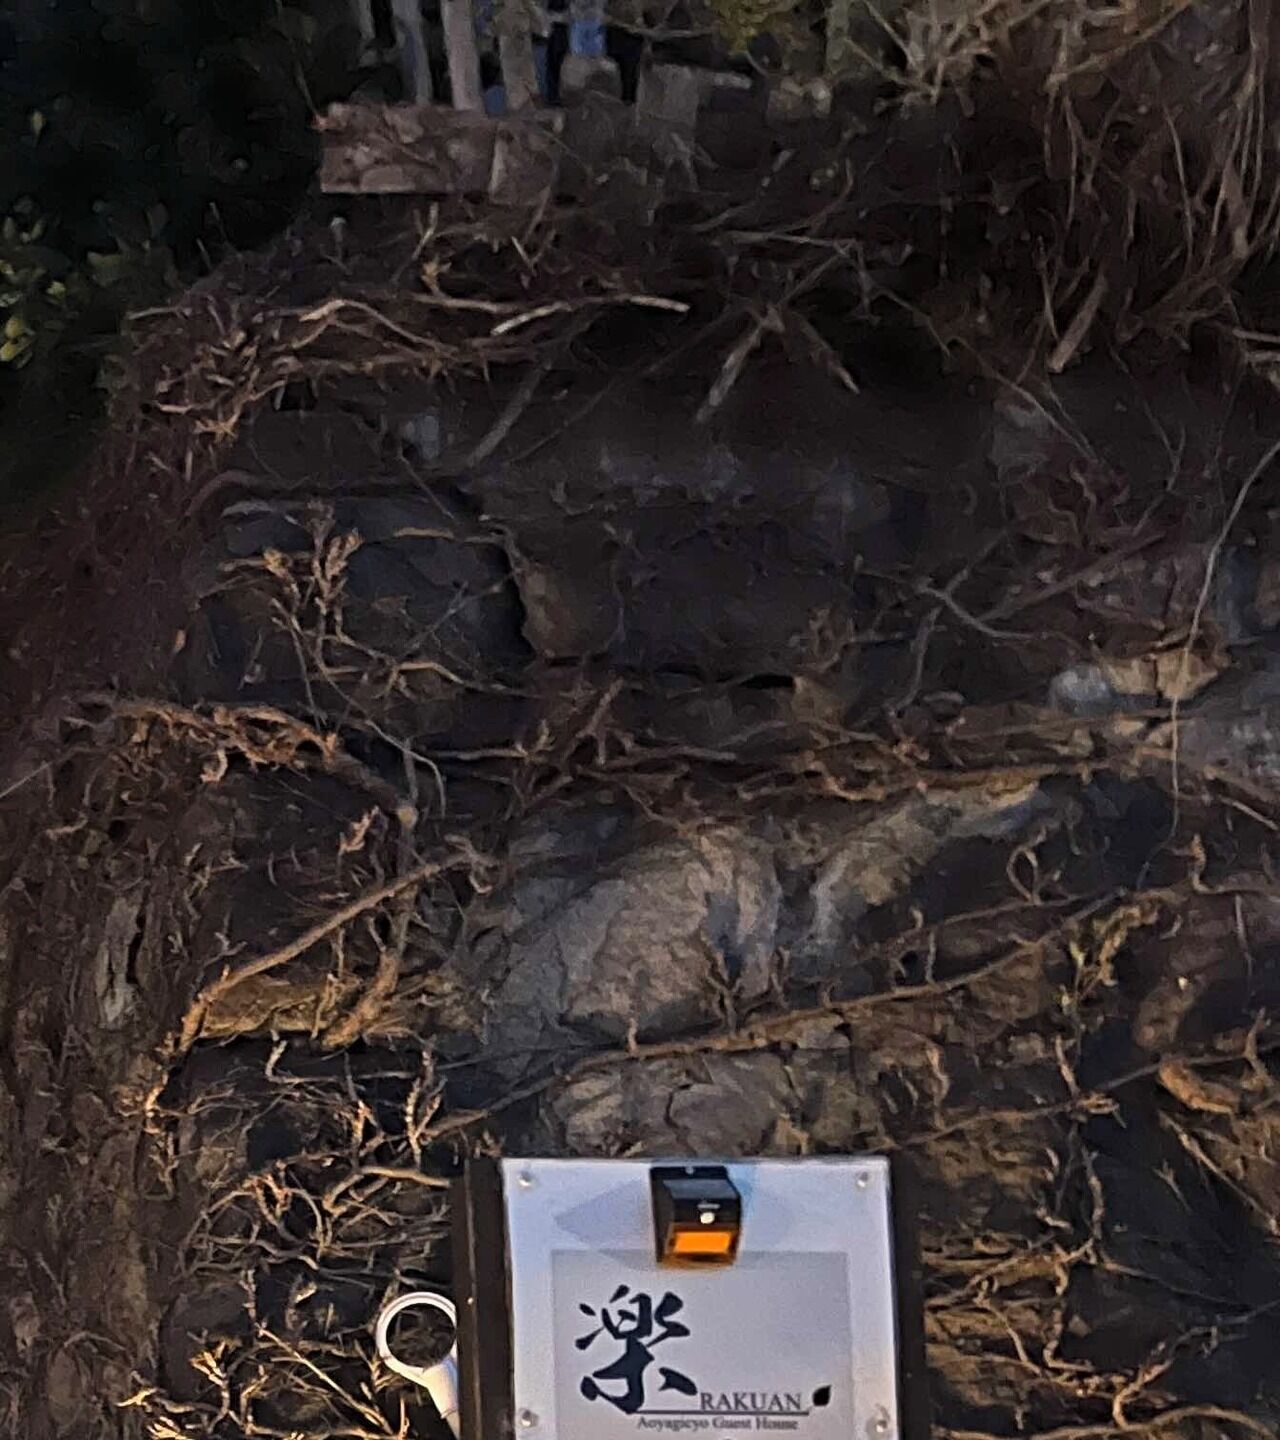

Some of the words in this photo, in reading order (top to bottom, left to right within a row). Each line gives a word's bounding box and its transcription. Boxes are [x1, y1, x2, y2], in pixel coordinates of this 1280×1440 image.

[699, 1392, 802, 1411] RAKUAN
[712, 1416, 752, 1430] Guest
[755, 1416, 799, 1430] House
